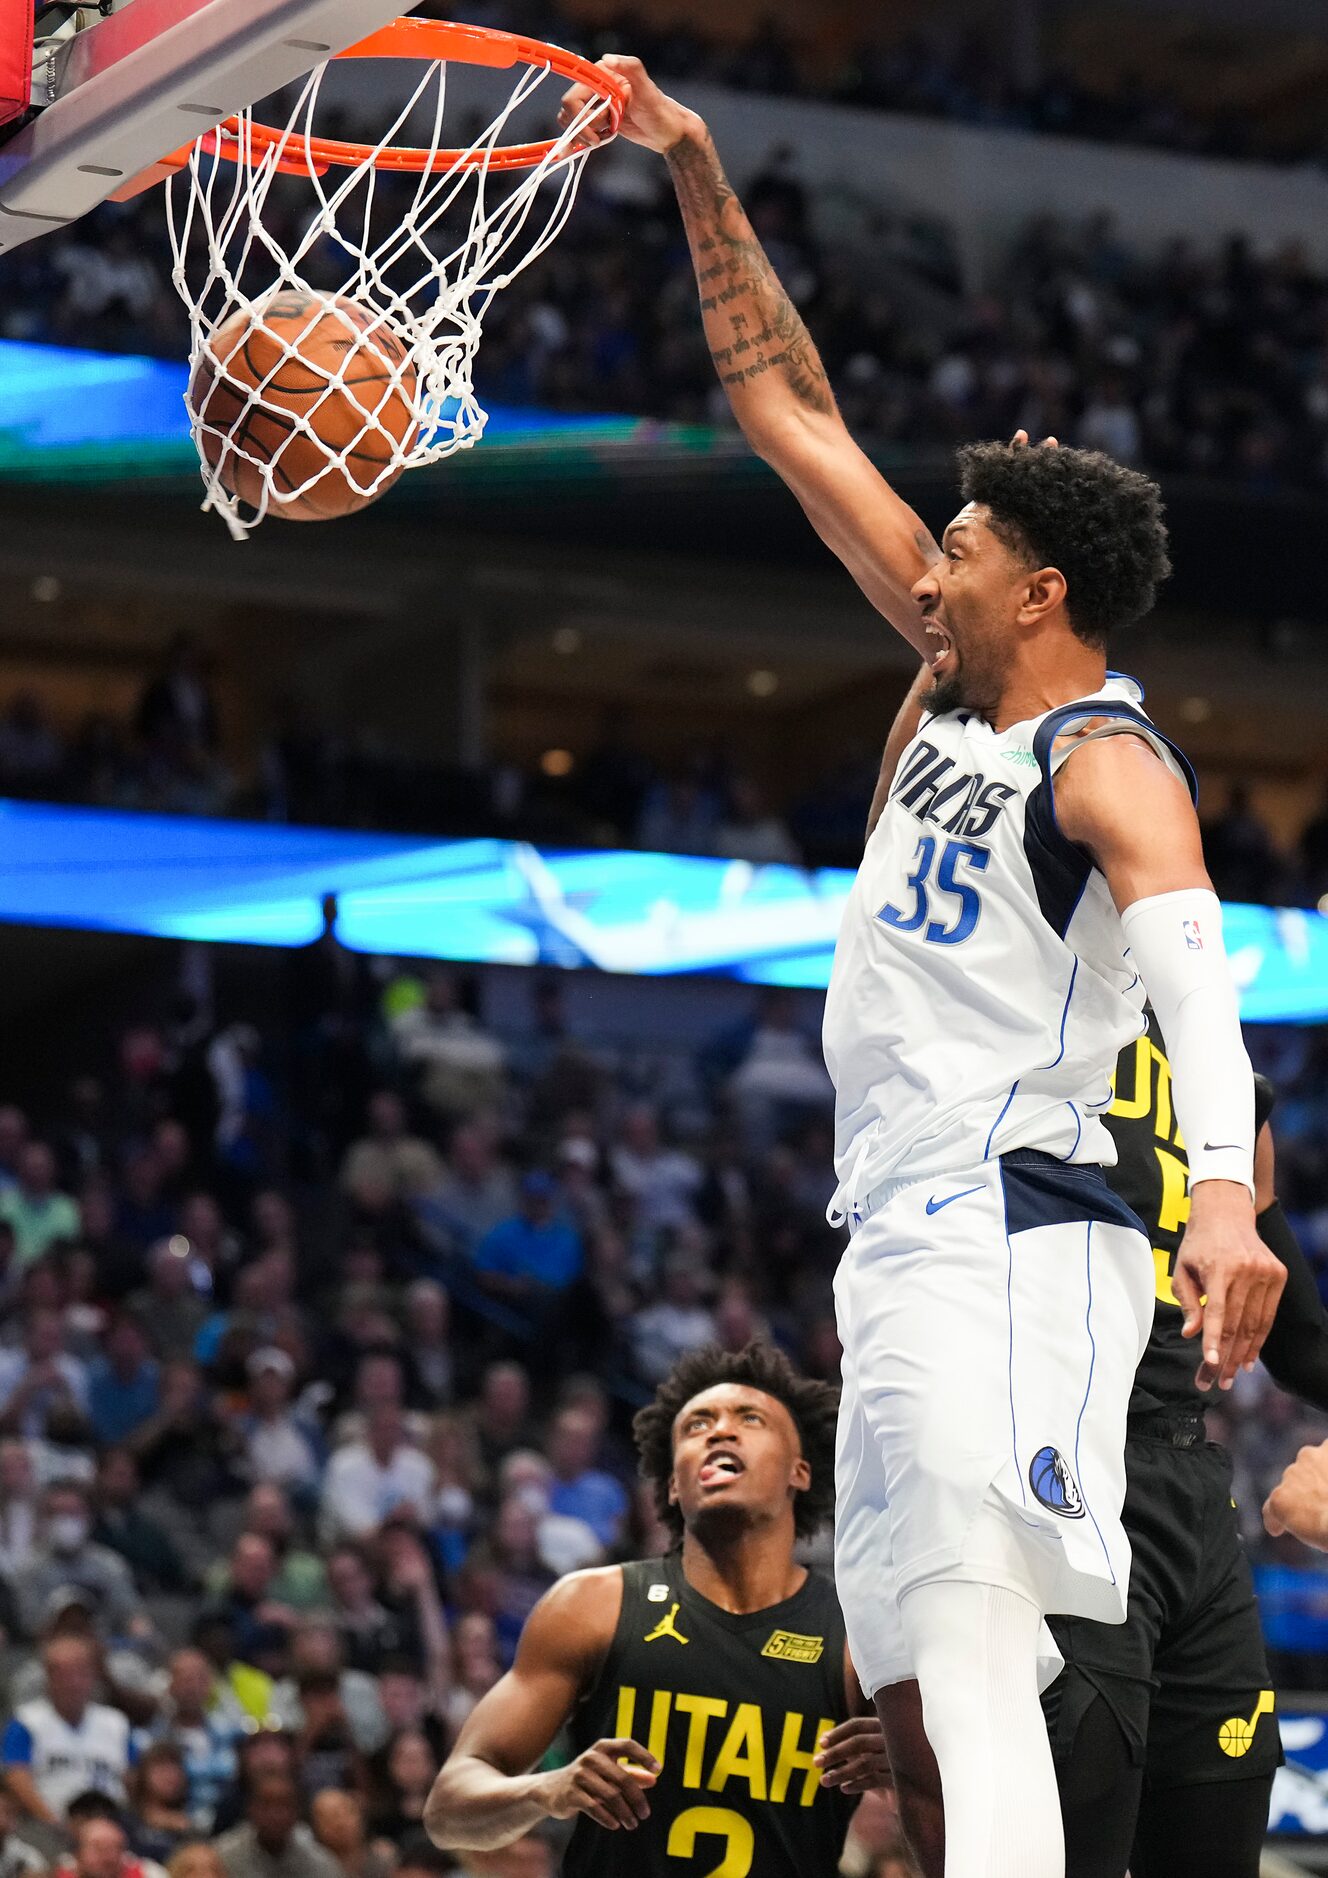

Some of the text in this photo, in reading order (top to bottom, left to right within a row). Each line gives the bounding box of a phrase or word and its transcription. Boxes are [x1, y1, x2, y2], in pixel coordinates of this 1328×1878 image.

[873, 834, 992, 947] 35
[647, 1584, 670, 1602] 6
[615, 1686, 837, 1807] UTAH
[666, 1806, 755, 1878] 2
